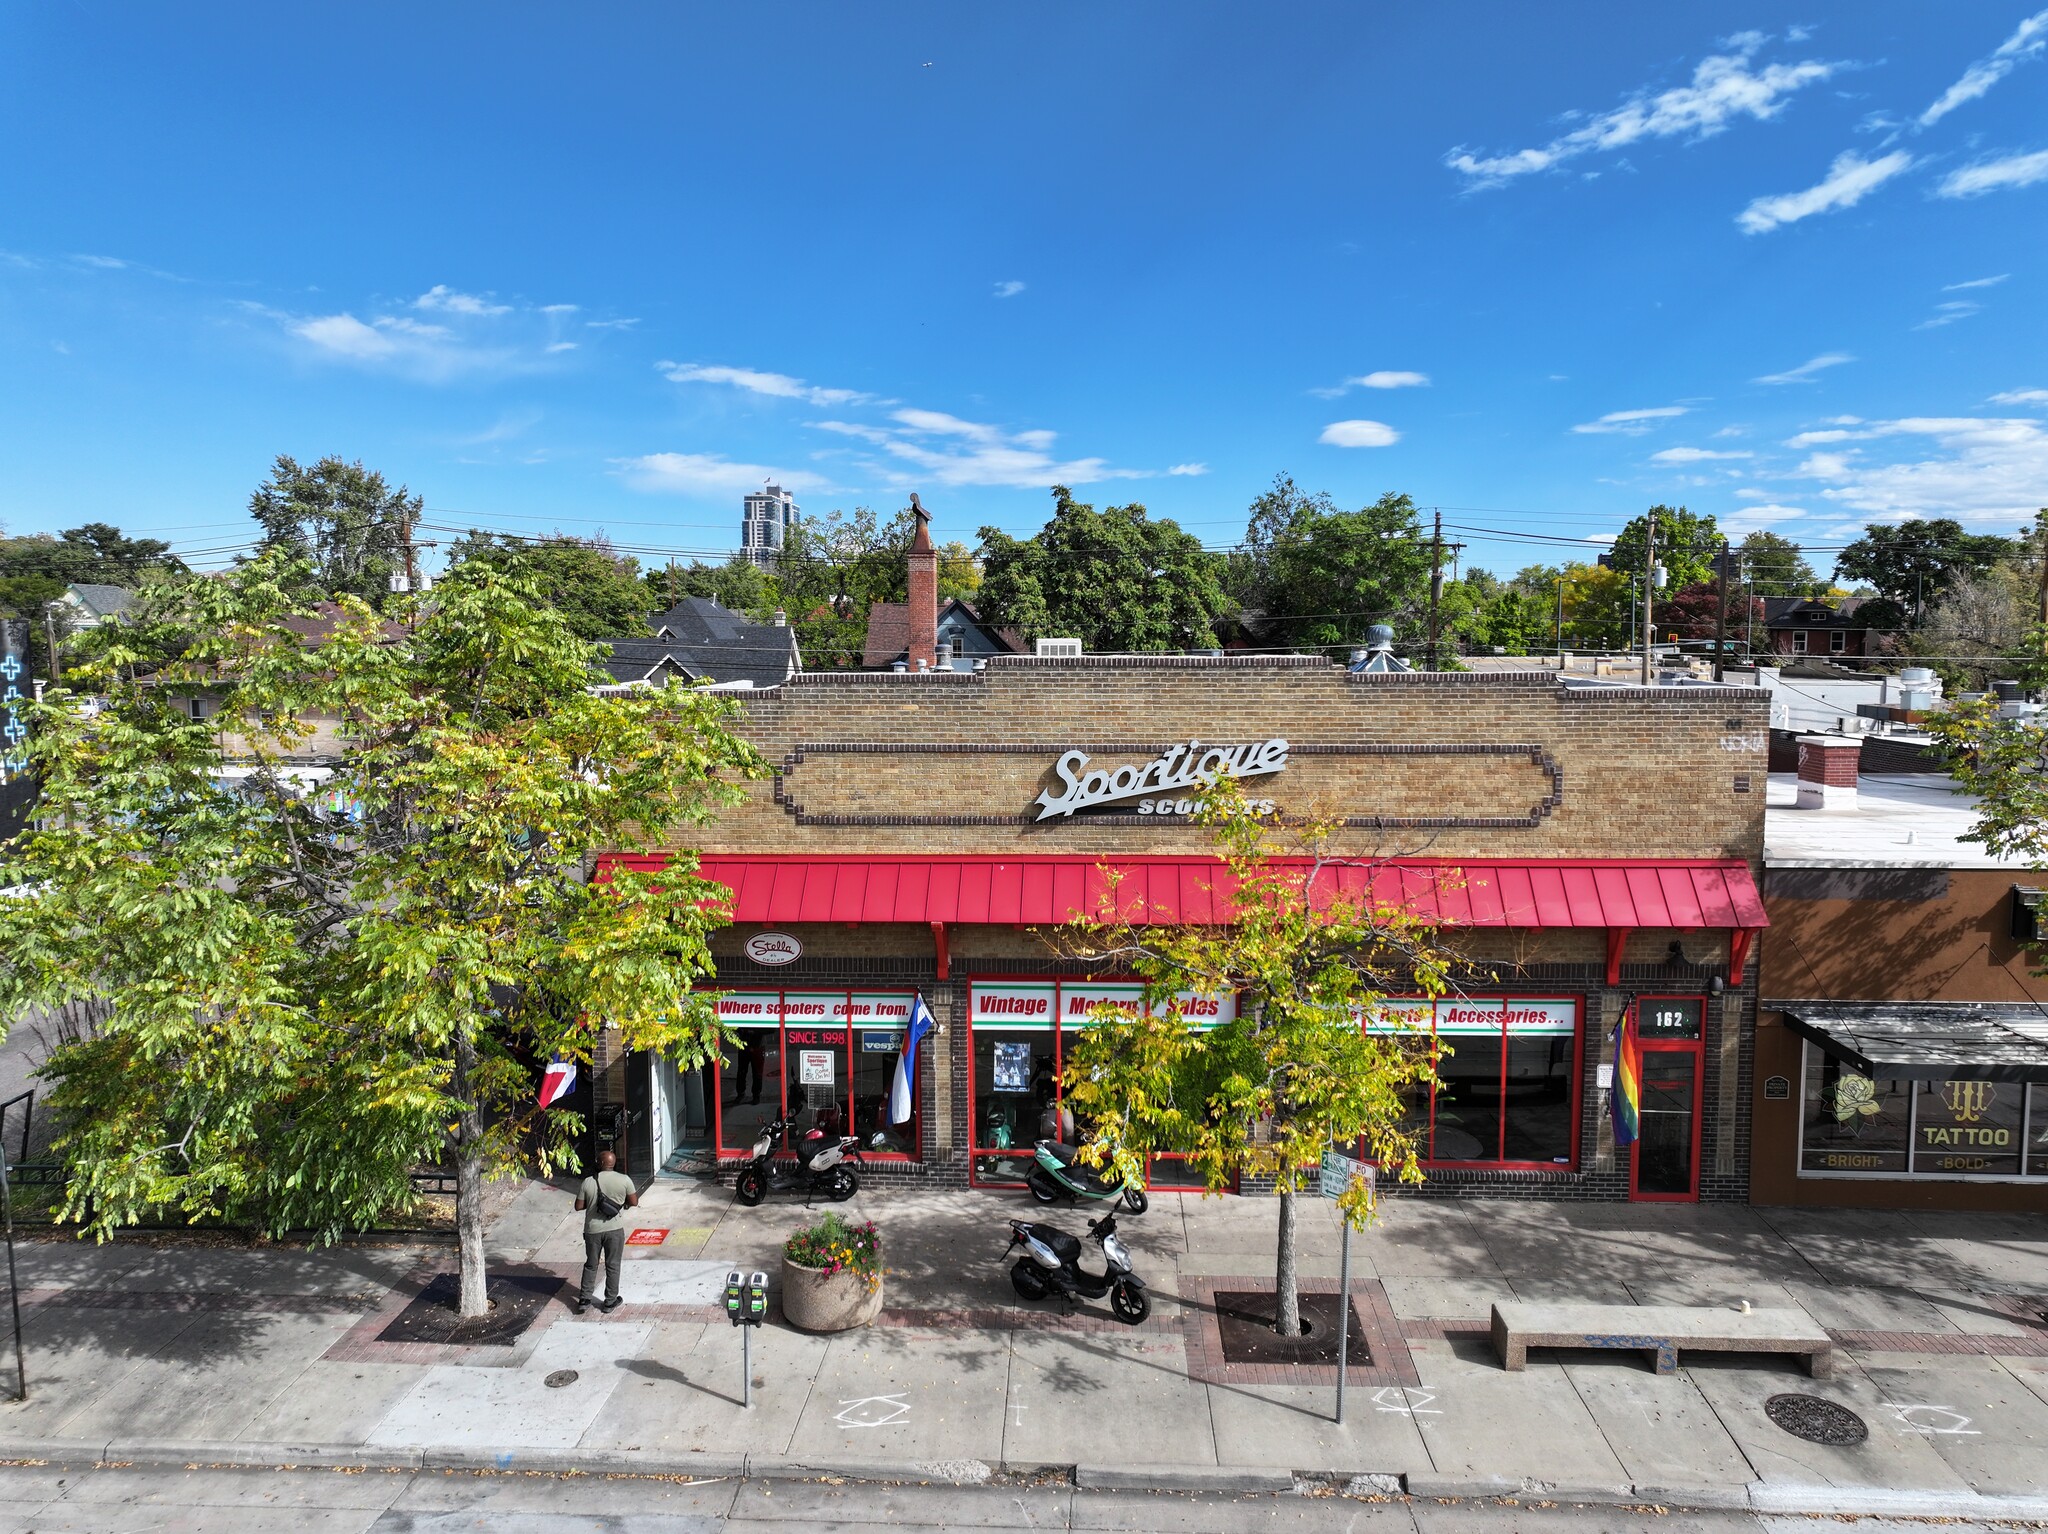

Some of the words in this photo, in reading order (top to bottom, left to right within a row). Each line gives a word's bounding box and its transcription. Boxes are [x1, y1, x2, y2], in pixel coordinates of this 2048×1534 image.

[1035, 739, 1290, 822] Sportique
[1137, 798, 1275, 816] scoors
[751, 940, 795, 956] Stella
[720, 1001, 762, 1014] Where
[766, 1003, 825, 1015] scooters
[833, 1004, 870, 1016] come
[876, 1003, 909, 1016] from.
[980, 995, 1047, 1015] Vintage
[1166, 997, 1219, 1016] Sales
[1656, 1011, 1683, 1027] 162
[788, 1031, 818, 1045] SINCE
[1923, 1127, 2009, 1146] TATTOO
[1828, 1154, 1880, 1168] BRIGHT
[1944, 1157, 1985, 1170] BOLD
